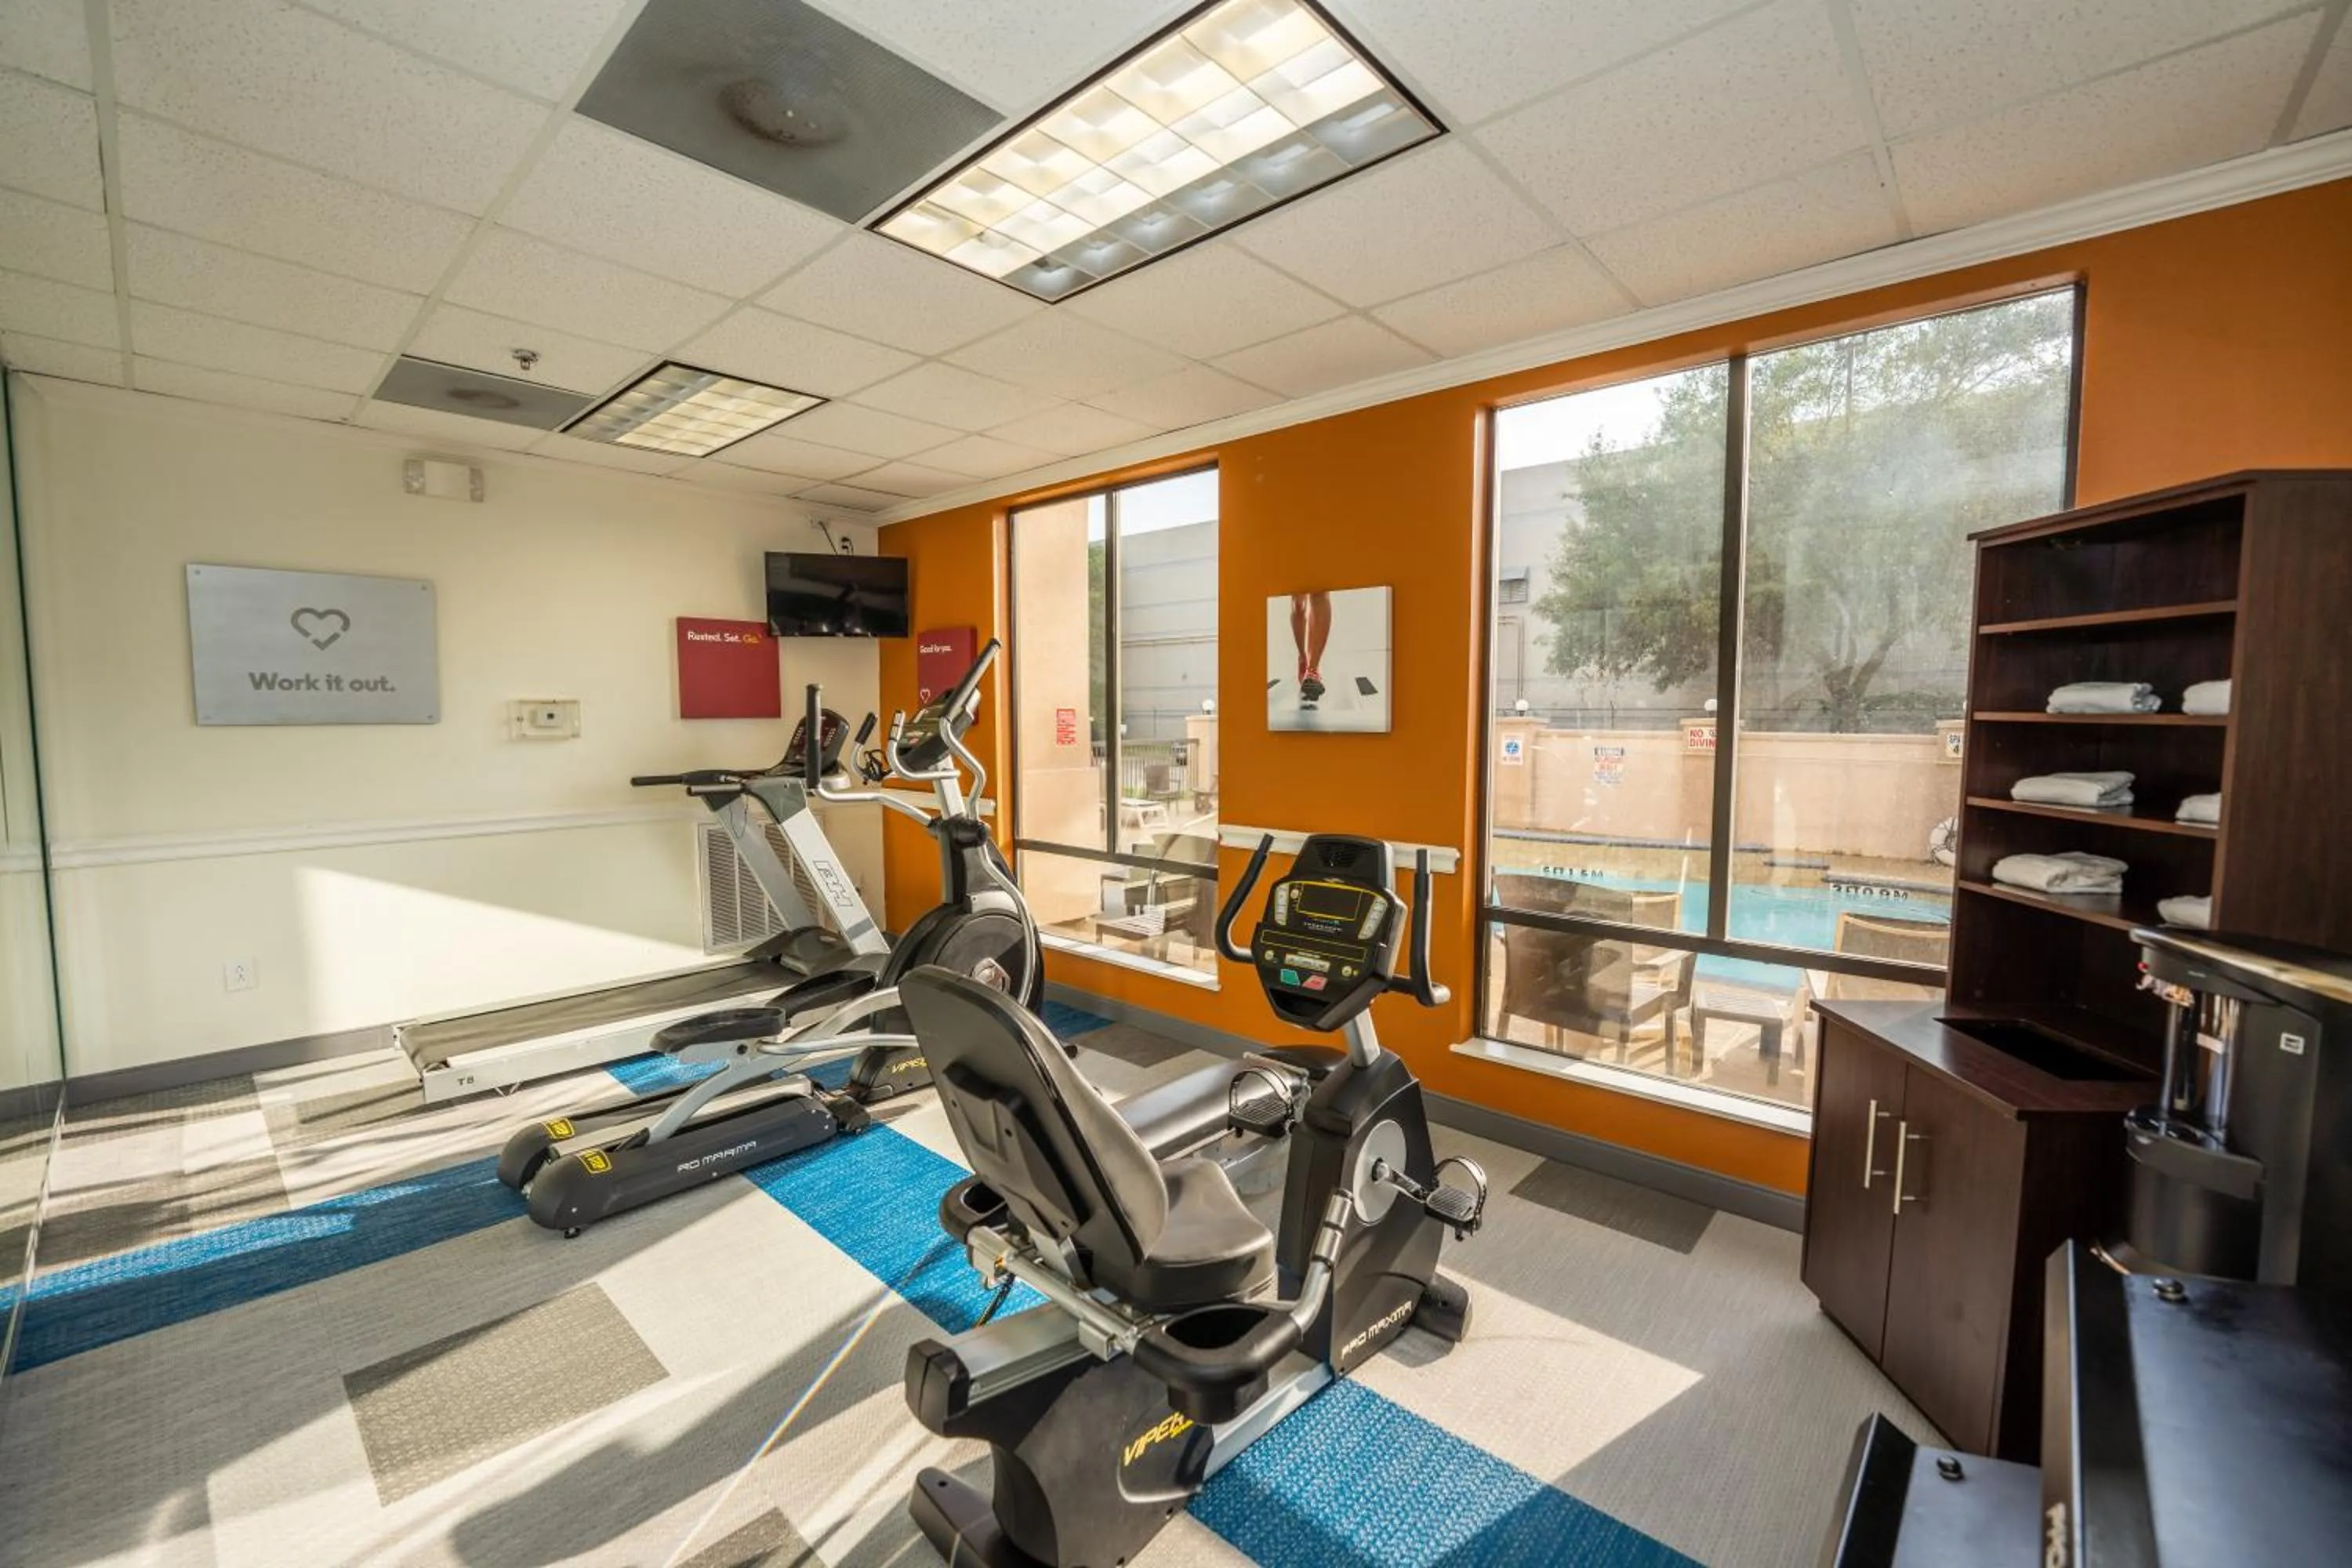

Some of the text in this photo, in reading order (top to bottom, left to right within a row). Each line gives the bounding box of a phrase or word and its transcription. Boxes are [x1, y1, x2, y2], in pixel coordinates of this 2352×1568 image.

[724, 633, 741, 642] Set.
[249, 672, 396, 692] Work it out.
[1690, 728, 1704, 738] NO
[1123, 1411, 1185, 1467] VIPER
